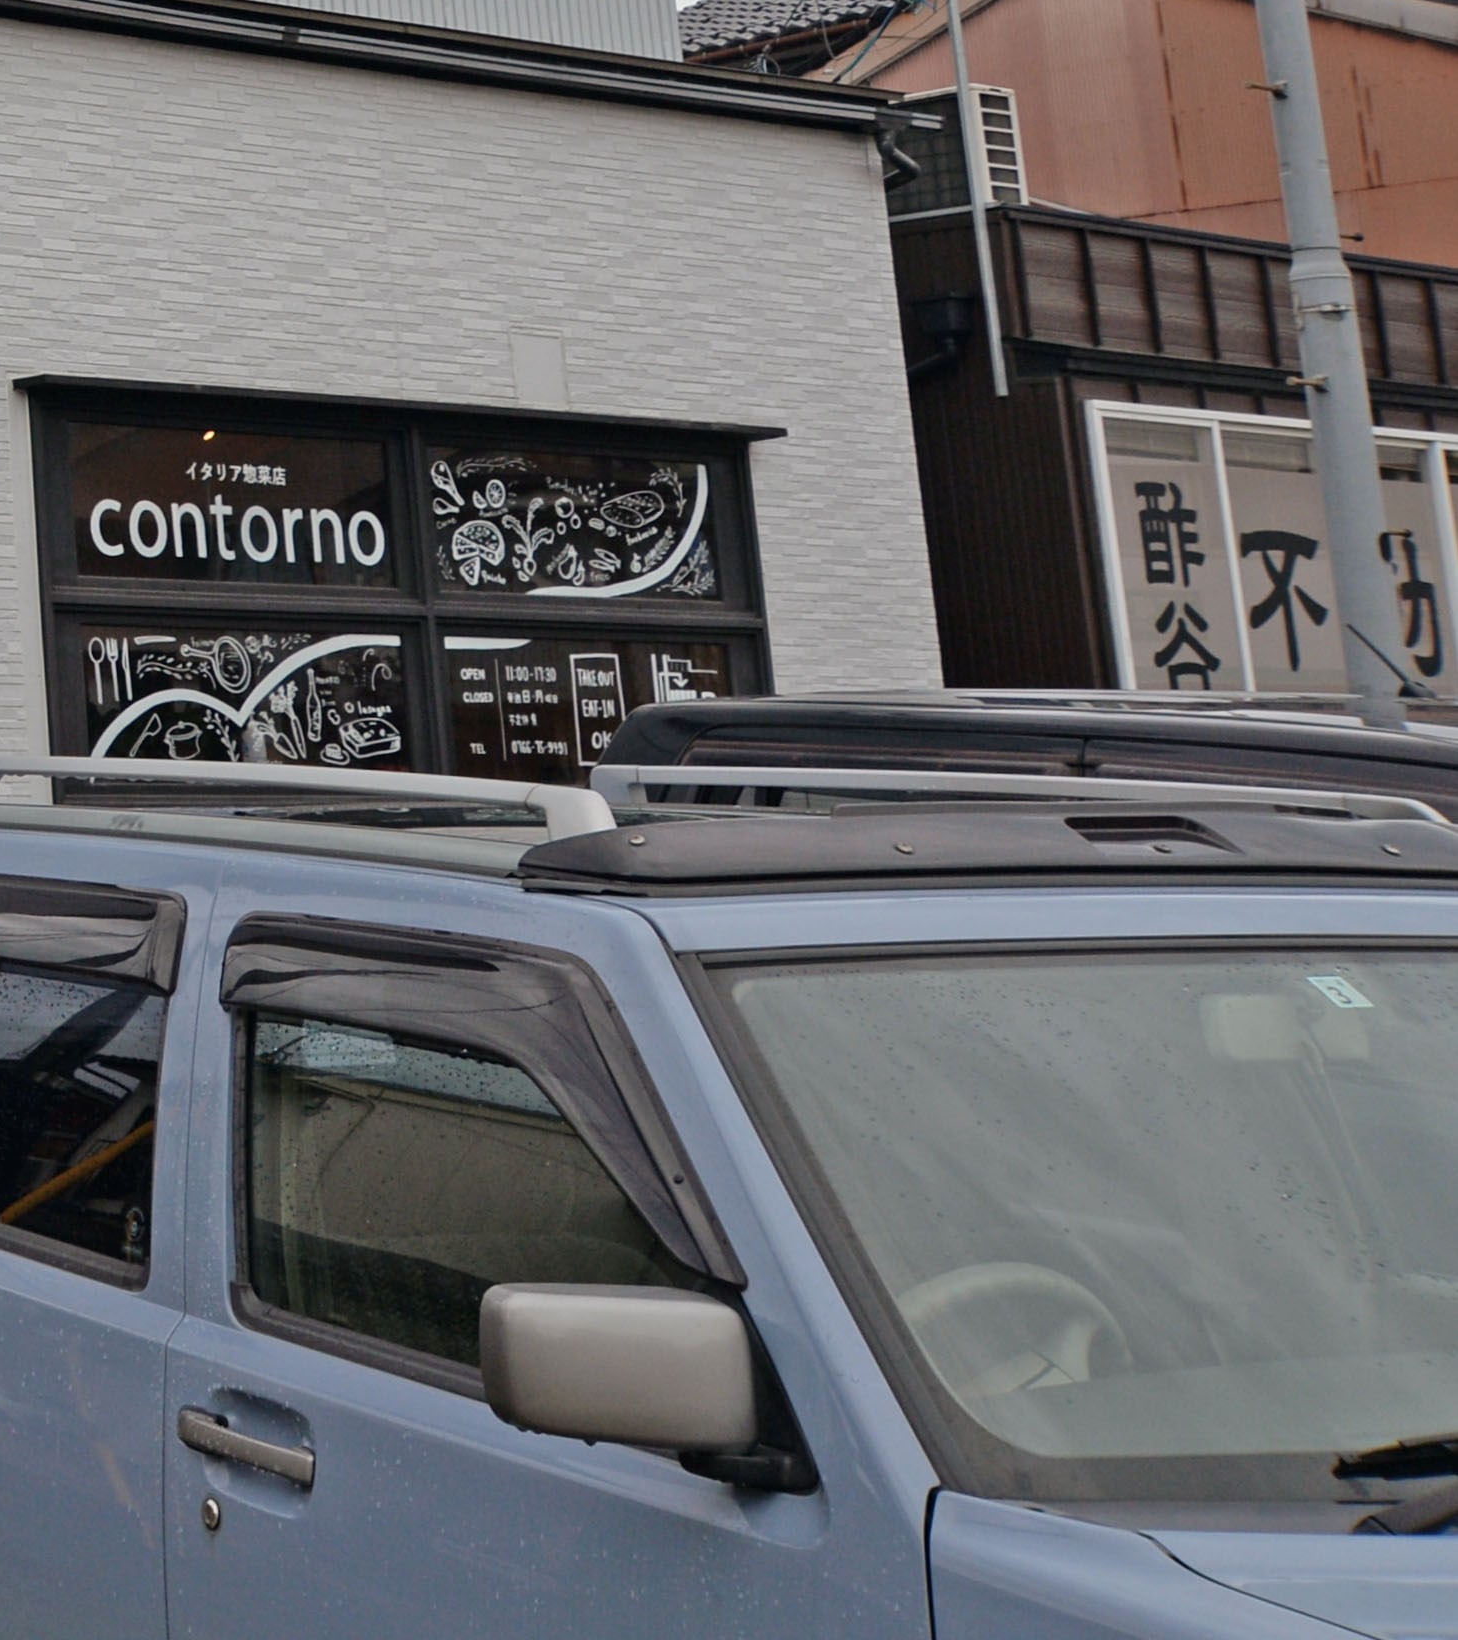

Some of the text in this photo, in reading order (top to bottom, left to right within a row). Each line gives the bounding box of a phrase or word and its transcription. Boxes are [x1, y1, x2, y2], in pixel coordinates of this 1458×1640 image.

[186, 461, 287, 486] イタリア惣菜店
[90, 494, 385, 567] contorno
[460, 668, 486, 681] OPEN
[577, 668, 615, 687] TAKE OUT
[463, 691, 494, 703] CLOSED
[582, 698, 615, 718] EAT-IN
[470, 742, 486, 755] TEL
